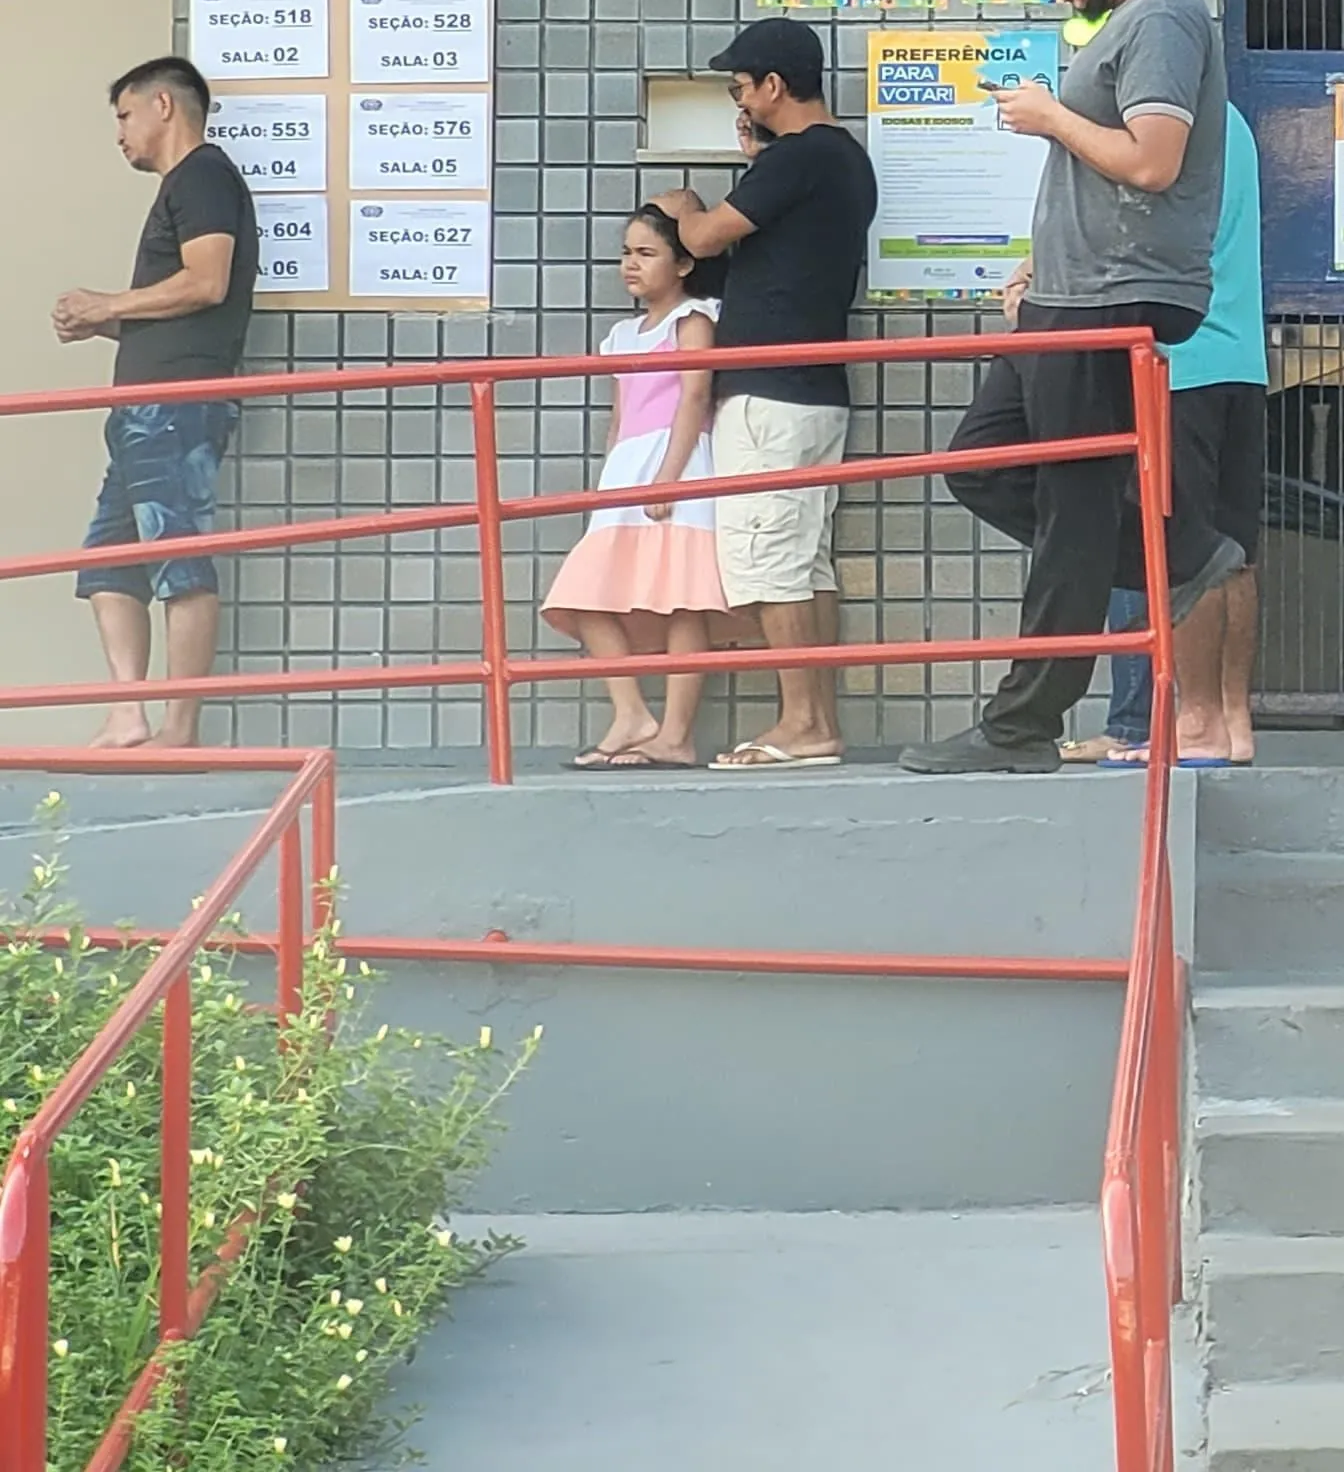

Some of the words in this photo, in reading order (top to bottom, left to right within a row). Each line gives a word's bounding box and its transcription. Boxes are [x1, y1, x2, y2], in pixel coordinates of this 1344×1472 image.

[208, 10, 270, 27] SEÇÃO:
[273, 9, 312, 24] 518
[368, 14, 430, 31] SEÇÃO:
[432, 14, 472, 29] 528
[221, 51, 270, 63] SALA:
[273, 47, 299, 63] 02
[380, 55, 429, 67] SALA:
[432, 51, 458, 67] 03
[882, 45, 1027, 61] PREFERÊNCIA
[882, 66, 934, 80] PARA
[882, 87, 954, 101] VOTAR!
[207, 123, 268, 140] SEÇÃO:
[271, 122, 310, 138] 553
[368, 121, 430, 138] SEÇÃO:
[432, 120, 472, 136] 576
[241, 164, 268, 176] LA:
[271, 160, 296, 176] 04
[380, 162, 428, 174] SALA:
[431, 159, 458, 174] 05
[273, 223, 312, 238] 604
[368, 228, 430, 245] SEÇÃO:
[433, 228, 472, 243] 627
[272, 261, 298, 276] 06
[380, 268, 428, 280] SALA:
[432, 266, 458, 280] 07
